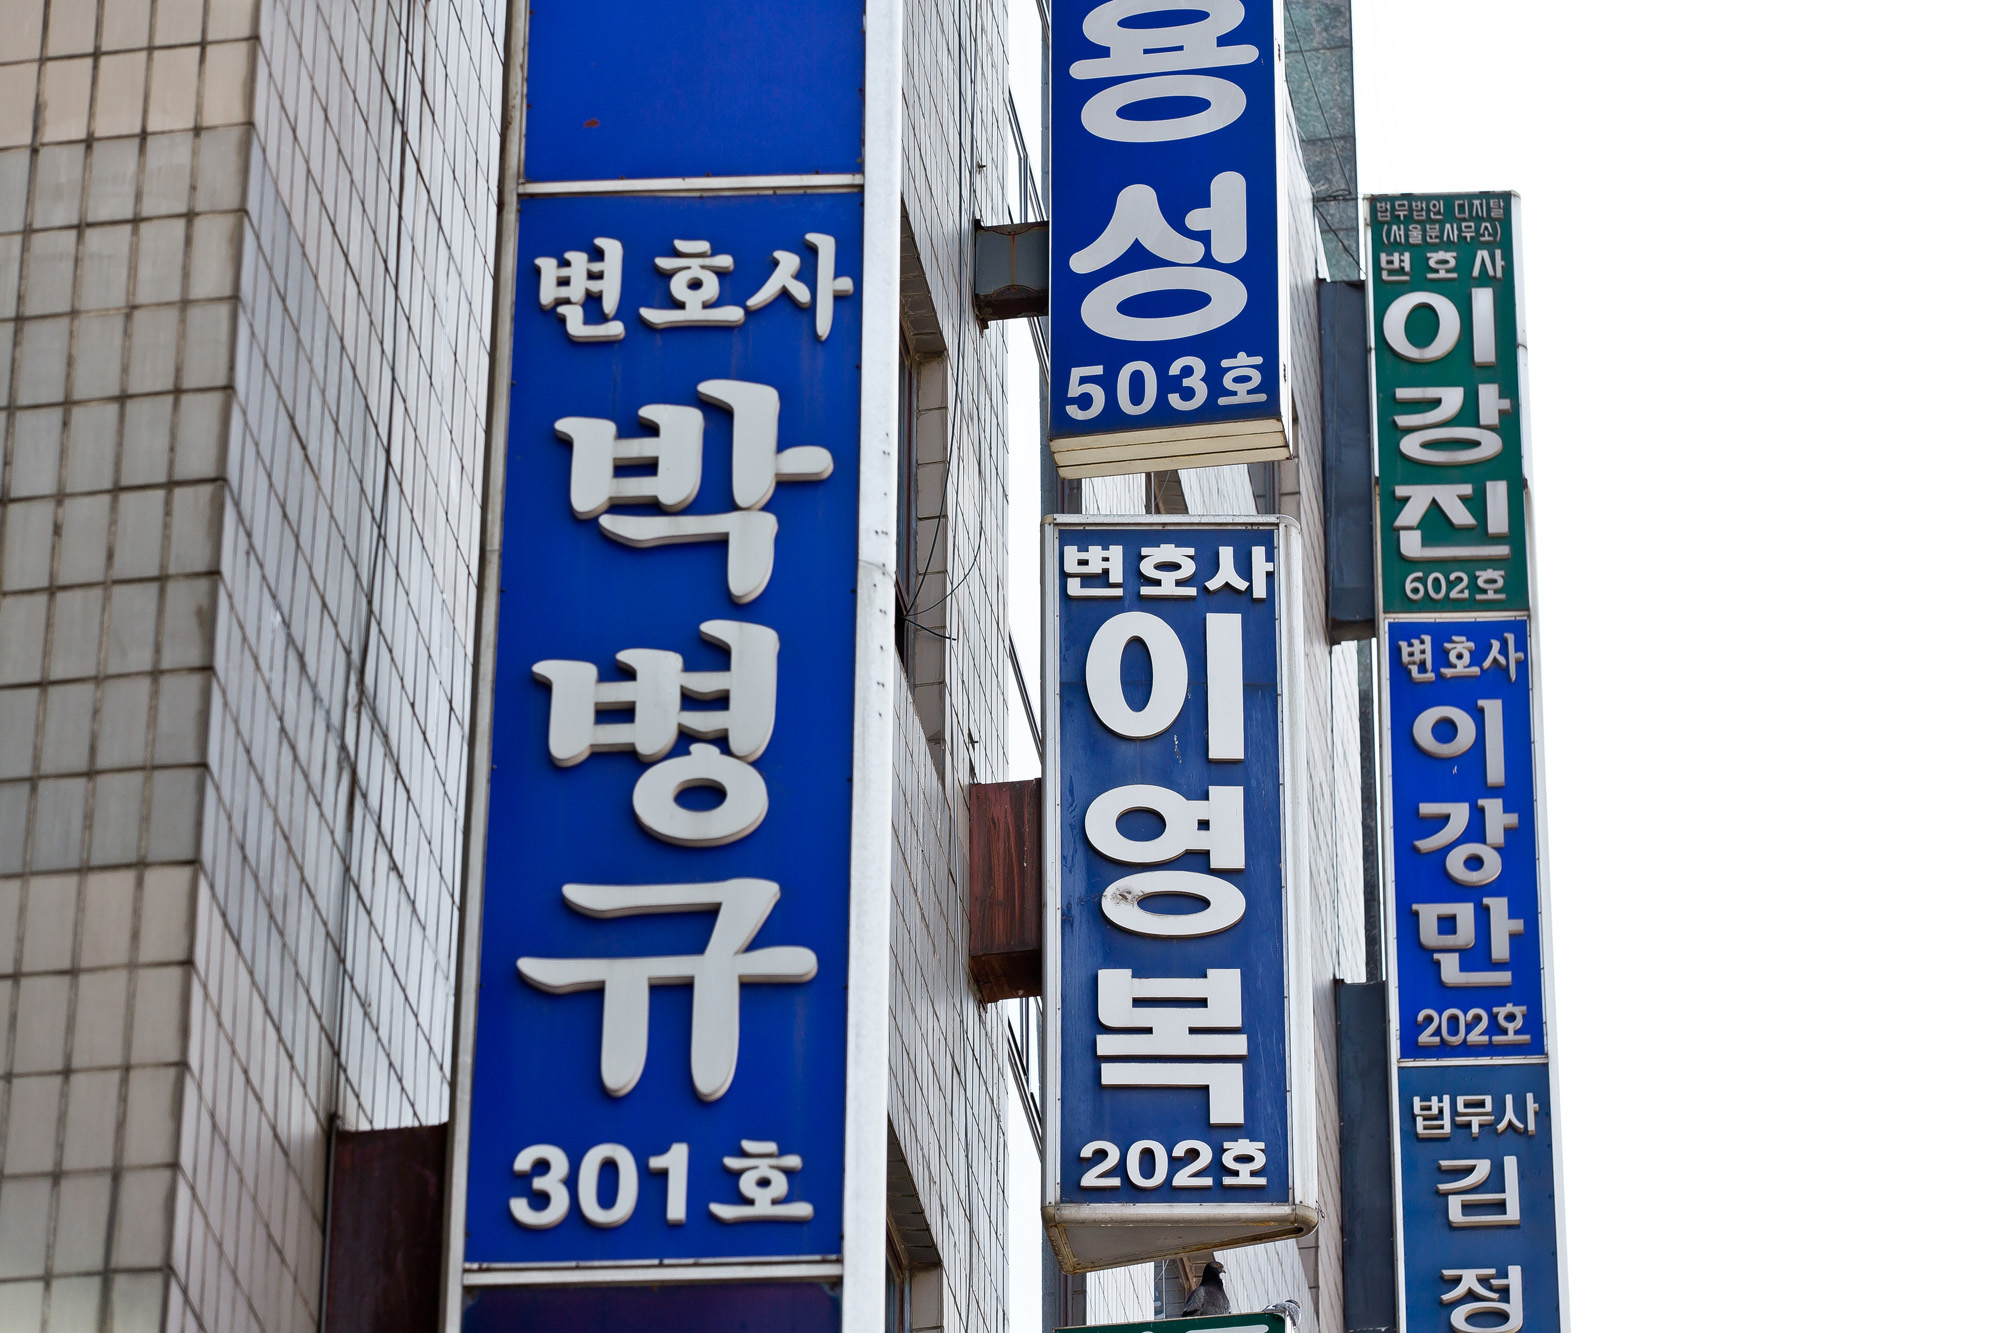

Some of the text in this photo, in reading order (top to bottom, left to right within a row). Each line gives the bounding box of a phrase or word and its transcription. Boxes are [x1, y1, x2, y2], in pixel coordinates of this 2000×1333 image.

[1069, 0, 1259, 342] 용성
[1376, 198, 1505, 222] 법무법인 디지탈
[1382, 221, 1501, 246] (서울분사무소)
[534, 232, 854, 343] 변호사
[1380, 248, 1506, 283] 변호사
[1065, 351, 1268, 421] 503호
[1382, 287, 1513, 562] 이강진
[1063, 543, 1274, 600] 변호사
[1404, 568, 1507, 602] 602호
[1399, 633, 1525, 683] 변호사
[517, 378, 834, 1102] 박병규
[1084, 610, 1249, 1127] 이영복
[1411, 698, 1525, 988] 이강만
[1417, 1002, 1532, 1047] 202호
[1412, 1092, 1539, 1139] 법무사
[508, 1138, 815, 1231] 301호
[1079, 1138, 1268, 1190] 202호
[1435, 1155, 1524, 1333] 김정
